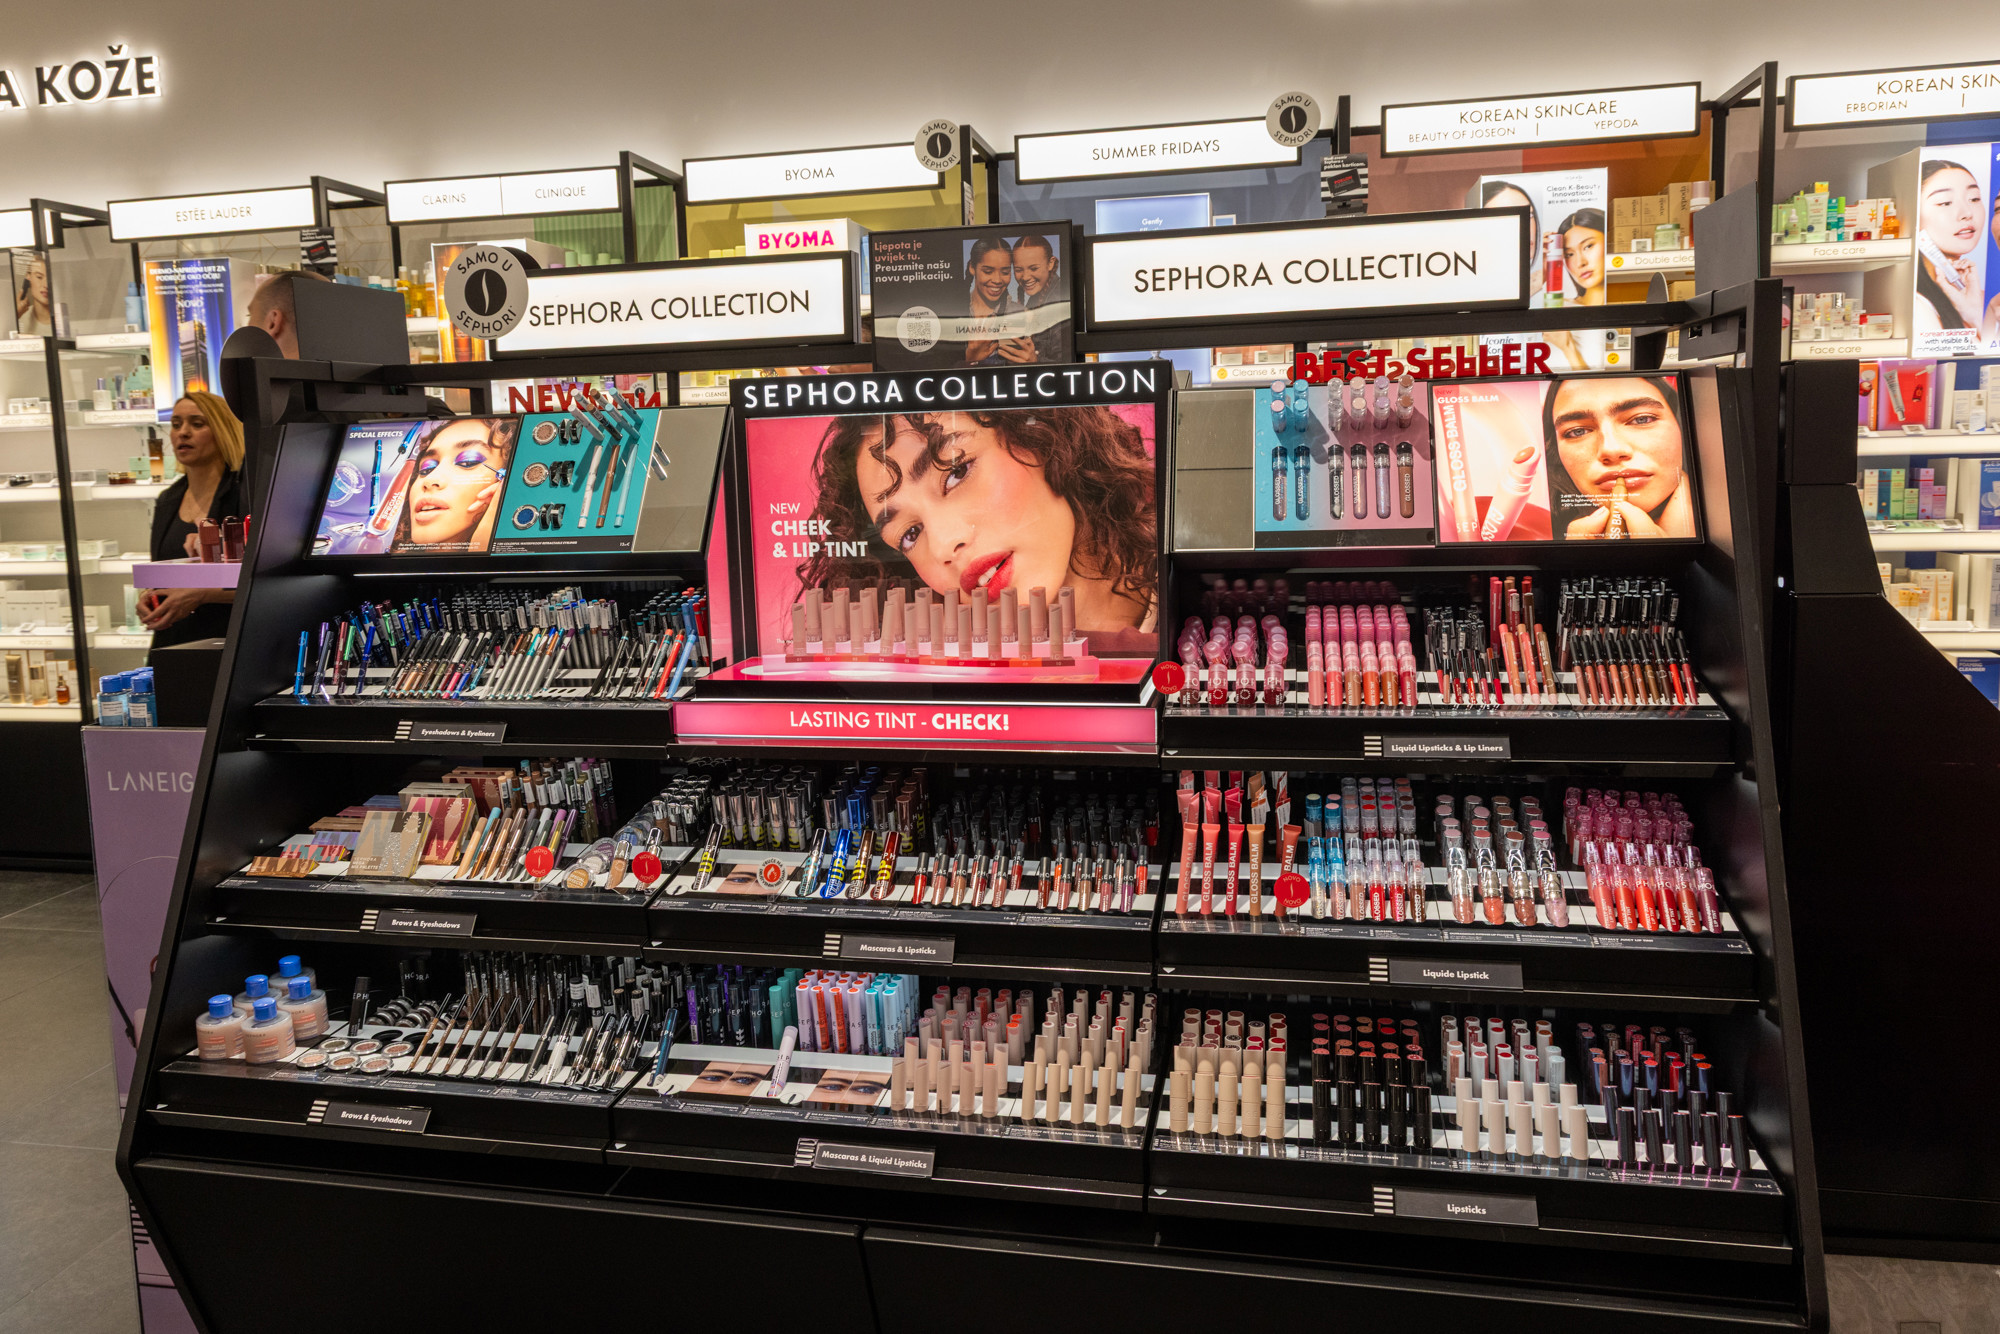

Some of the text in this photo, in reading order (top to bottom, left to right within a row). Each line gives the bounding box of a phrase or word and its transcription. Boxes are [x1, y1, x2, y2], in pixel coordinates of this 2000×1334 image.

[36, 44, 158, 106] KOŽE
[1877, 77, 1954, 95] KOREAN
[1274, 95, 1312, 110] SAMO U
[1846, 100, 1908, 114] ERBORIAN
[1459, 100, 1618, 124] KOREAN SKINCARE
[922, 122, 956, 136] SAMO U
[1594, 119, 1639, 130] YEPODA
[1273, 128, 1313, 144] SEPHORI
[1408, 127, 1516, 143] BEAUTY OF JOSEON
[1092, 140, 1220, 161] SUMMER FRIDAYS
[785, 167, 835, 181] BYOMA
[422, 193, 467, 205] CLARINS
[535, 185, 587, 200] CLINIQUE
[1552, 190, 1593, 198] Innovations
[210, 206, 253, 220] LAUDER
[1141, 217, 1163, 228] Gently
[758, 229, 835, 250] BYOMA
[874, 240, 923, 252] Ljepota je
[874, 251, 921, 263] uvijek tu.
[1813, 246, 1866, 257] Face care
[457, 251, 514, 275] SAMO U
[875, 260, 951, 273] Preuzmite našu
[1634, 255, 1670, 265] Double
[875, 271, 953, 284] novu aplikaciju.
[1134, 250, 1477, 293] SEPHORA COLLECTION
[529, 289, 810, 327] SEPHORA COLLECTION
[456, 305, 517, 334] SEPHORI
[1945, 329, 1976, 337] skincare
[1963, 336, 1969, 344] &
[1485, 336, 1514, 346] Iconic
[1809, 345, 1862, 354] Face care
[1295, 342, 1553, 385] BEST SELLER
[1232, 367, 1268, 378] Cleanse
[1270, 368, 1277, 376] &
[744, 368, 1156, 409] SEPHORA COLLECTION
[1437, 395, 1500, 404] GLOSS BALM
[349, 430, 403, 439] SPECIAL EFFECTS
[1443, 405, 1467, 492] GLOSS BALM
[382, 491, 400, 520] SPECIAL
[769, 502, 802, 515] NEW
[771, 519, 833, 537] CHEEK
[772, 540, 868, 559] & LIP TINT
[1161, 663, 1178, 672] NOVO
[1161, 684, 1178, 693] NOVO
[790, 711, 1010, 732] LASTING TINT CHECK!
[421, 728, 460, 737] Eyeshadows
[467, 729, 496, 738] Eyeliners
[1391, 743, 1503, 753] Liquid Lipsticks & Lip Liners
[698, 851, 713, 873] UP
[1283, 844, 1295, 872] BALM
[831, 857, 847, 882] UP
[851, 859, 867, 882] UP
[876, 859, 891, 882] UP
[1202, 842, 1214, 902] GLOSS BALM
[1226, 842, 1238, 902] GLOSS BALM
[1250, 843, 1259, 904] GLOSS BALM
[1284, 898, 1302, 906] NOVO
[391, 918, 461, 929] Brows & Eyeshadows
[860, 944, 937, 955] Mascaras & Lipsticks
[1422, 969, 1490, 981] Liquide Lipstick
[341, 1111, 412, 1126] Brows & Eyeshadows
[822, 1150, 927, 1169] Mascaras & Liquid Lipsticks
[1446, 1203, 1487, 1216] Lipsticks
